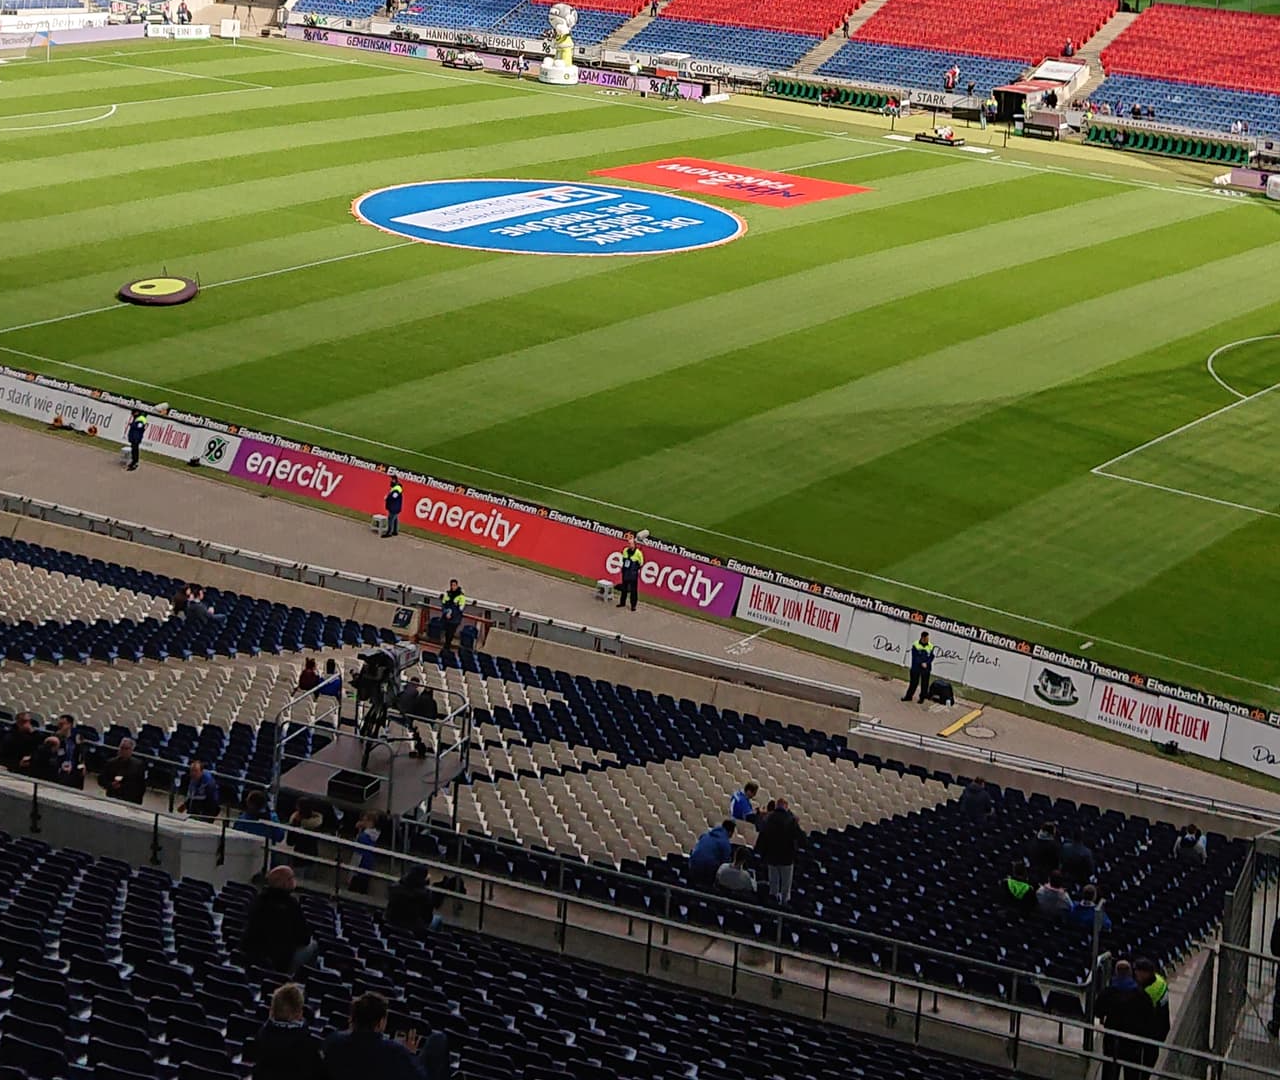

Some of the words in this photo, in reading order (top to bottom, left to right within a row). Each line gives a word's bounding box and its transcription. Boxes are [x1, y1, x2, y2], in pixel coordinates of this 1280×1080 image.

[346, 35, 391, 52] GEMEINSAM
[393, 41, 418, 55] STARK
[602, 75, 629, 86] STARK
[916, 93, 946, 106] STARK
[658, 163, 796, 189] FANSHOW
[597, 201, 649, 217] DIE
[489, 210, 602, 237] TRIBÜNE
[552, 214, 655, 236] GRÜSST
[656, 216, 703, 231] DIE
[575, 225, 661, 246] BANK
[7, 387, 31, 408] stark
[34, 397, 53, 414] wie
[55, 401, 79, 419] eine
[81, 406, 112, 429] Wand
[168, 410, 202, 426] Eisenbach
[165, 422, 191, 450] HEIDEN
[238, 427, 275, 444] Eisenbach
[205, 438, 224, 461] 96
[312, 446, 350, 463] Eisenbach
[246, 451, 343, 497] enercity
[387, 466, 426, 486] Eisenbach
[467, 487, 507, 508] Eisenbach
[416, 497, 521, 547] enercity
[549, 510, 590, 530] Eisenbach
[606, 552, 724, 607] eercity
[727, 559, 775, 582] Eisenbach
[750, 584, 779, 610] HEINZ
[783, 598, 802, 620] VON
[804, 597, 841, 634] HEIDEN
[823, 587, 873, 610] Eisenbach
[926, 614, 979, 638] Eisenbach
[873, 635, 901, 654] Das
[1032, 644, 1090, 671] Eisenbach
[1146, 678, 1206, 705] Eisenbach
[1100, 685, 1136, 721] HEINZ
[1139, 706, 1162, 728] VON
[1164, 705, 1210, 743] HEIDEN
